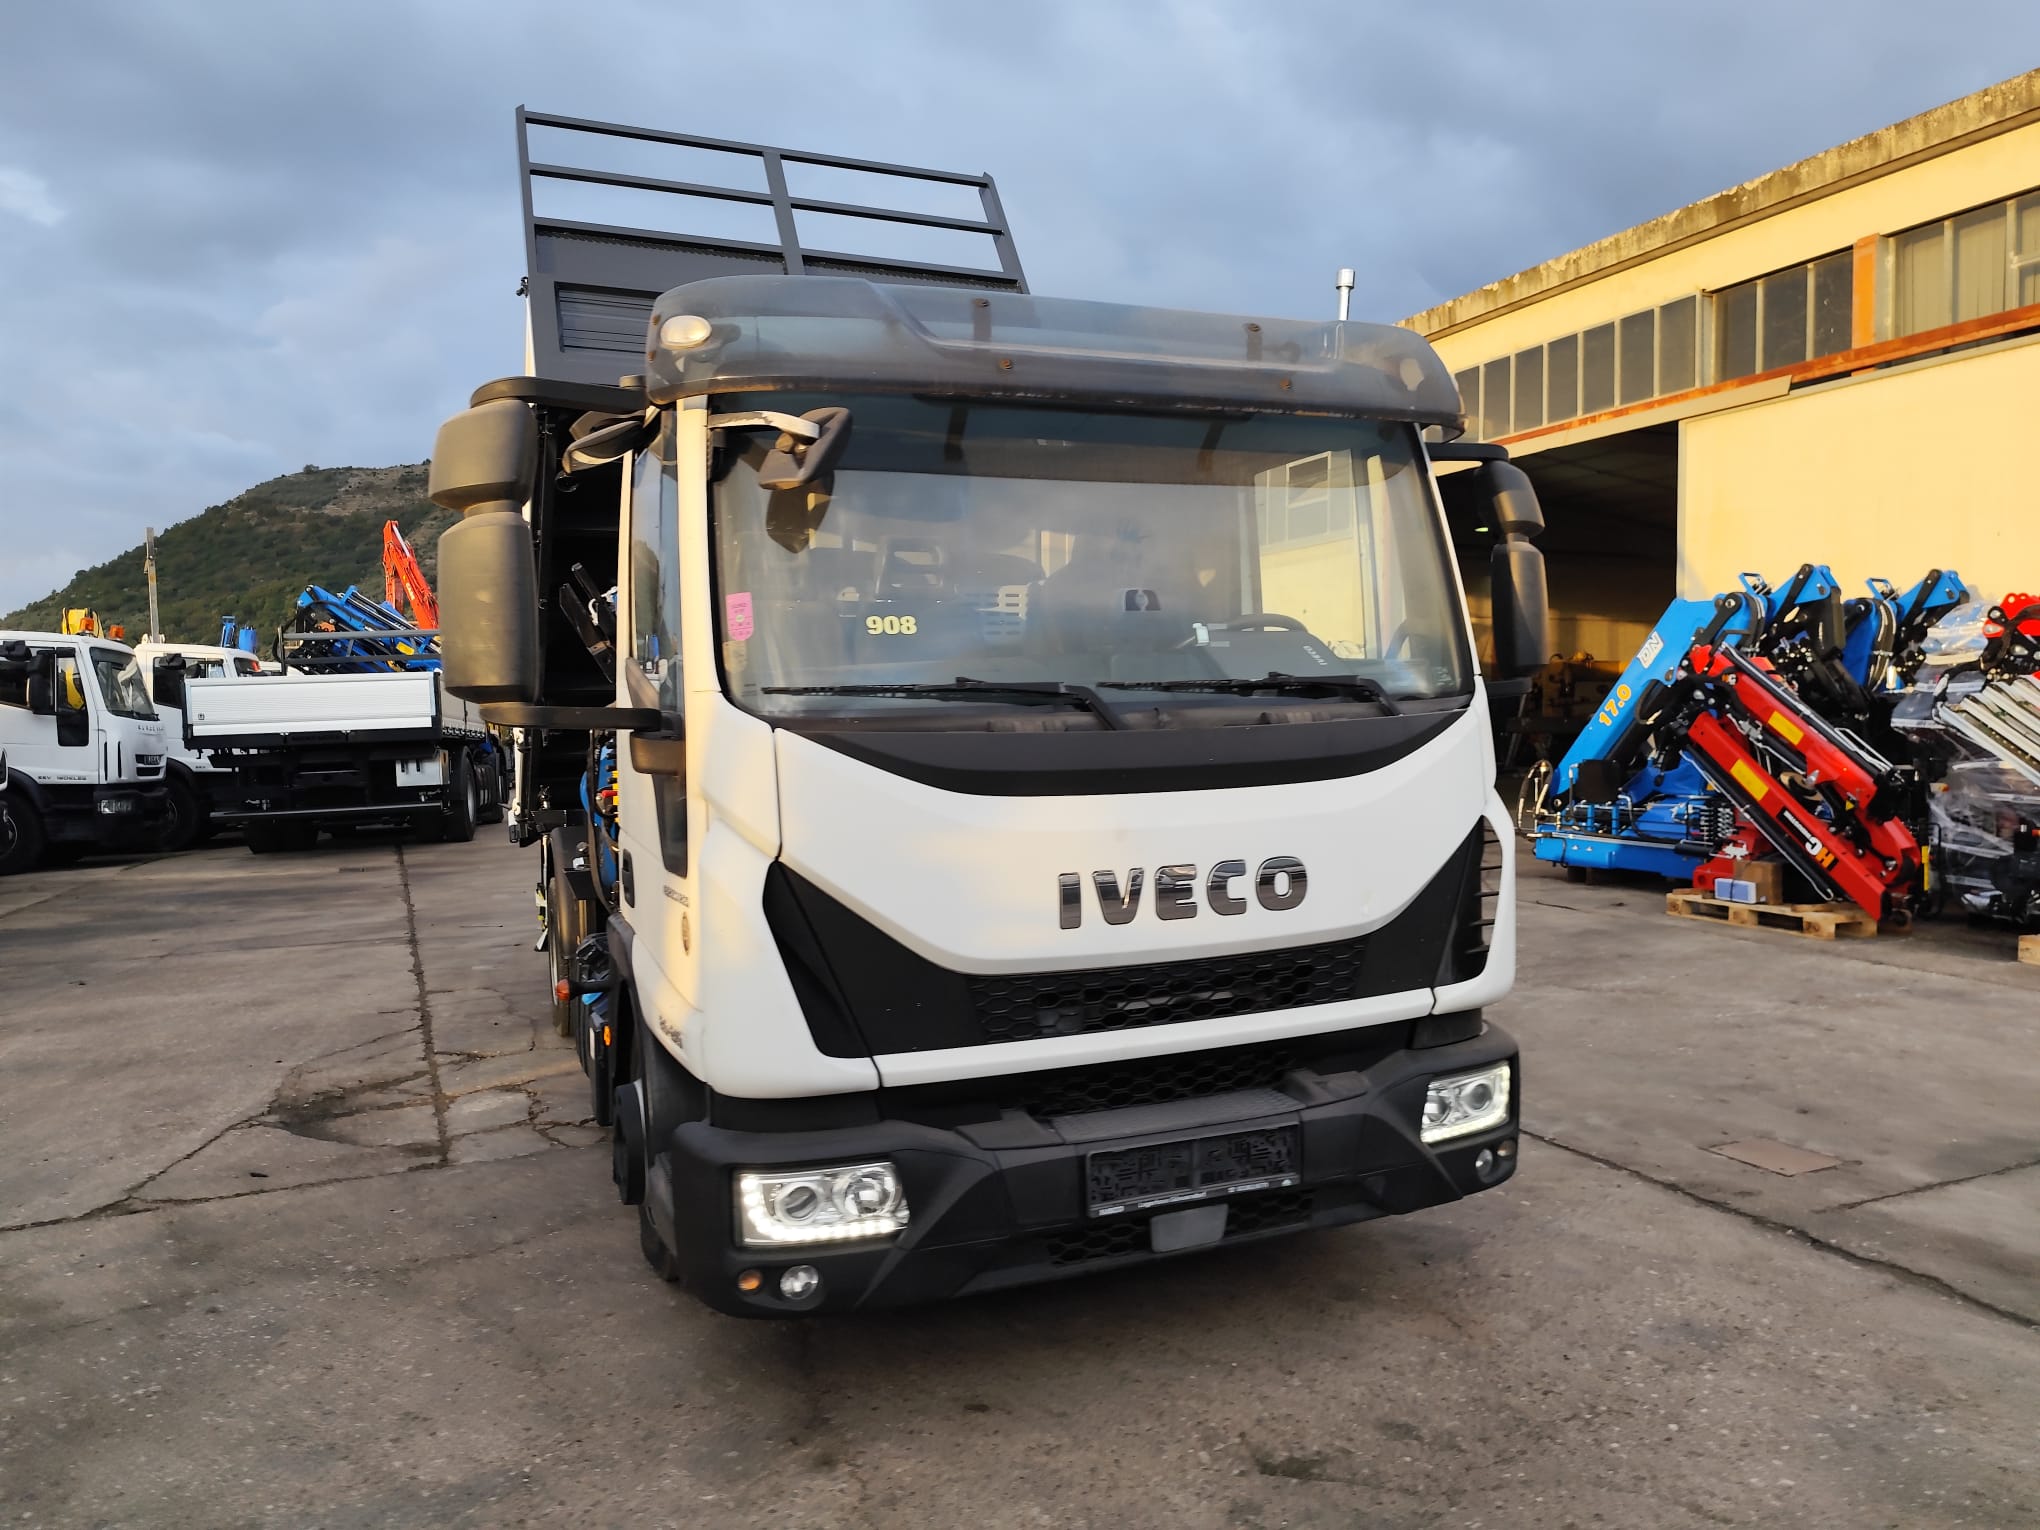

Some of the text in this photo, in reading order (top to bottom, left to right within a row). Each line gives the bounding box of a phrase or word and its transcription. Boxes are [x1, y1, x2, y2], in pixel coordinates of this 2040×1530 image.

[865, 615, 918, 635] 908
[1599, 684, 1632, 726] 17.0
[1058, 856, 1308, 929] IVECO
